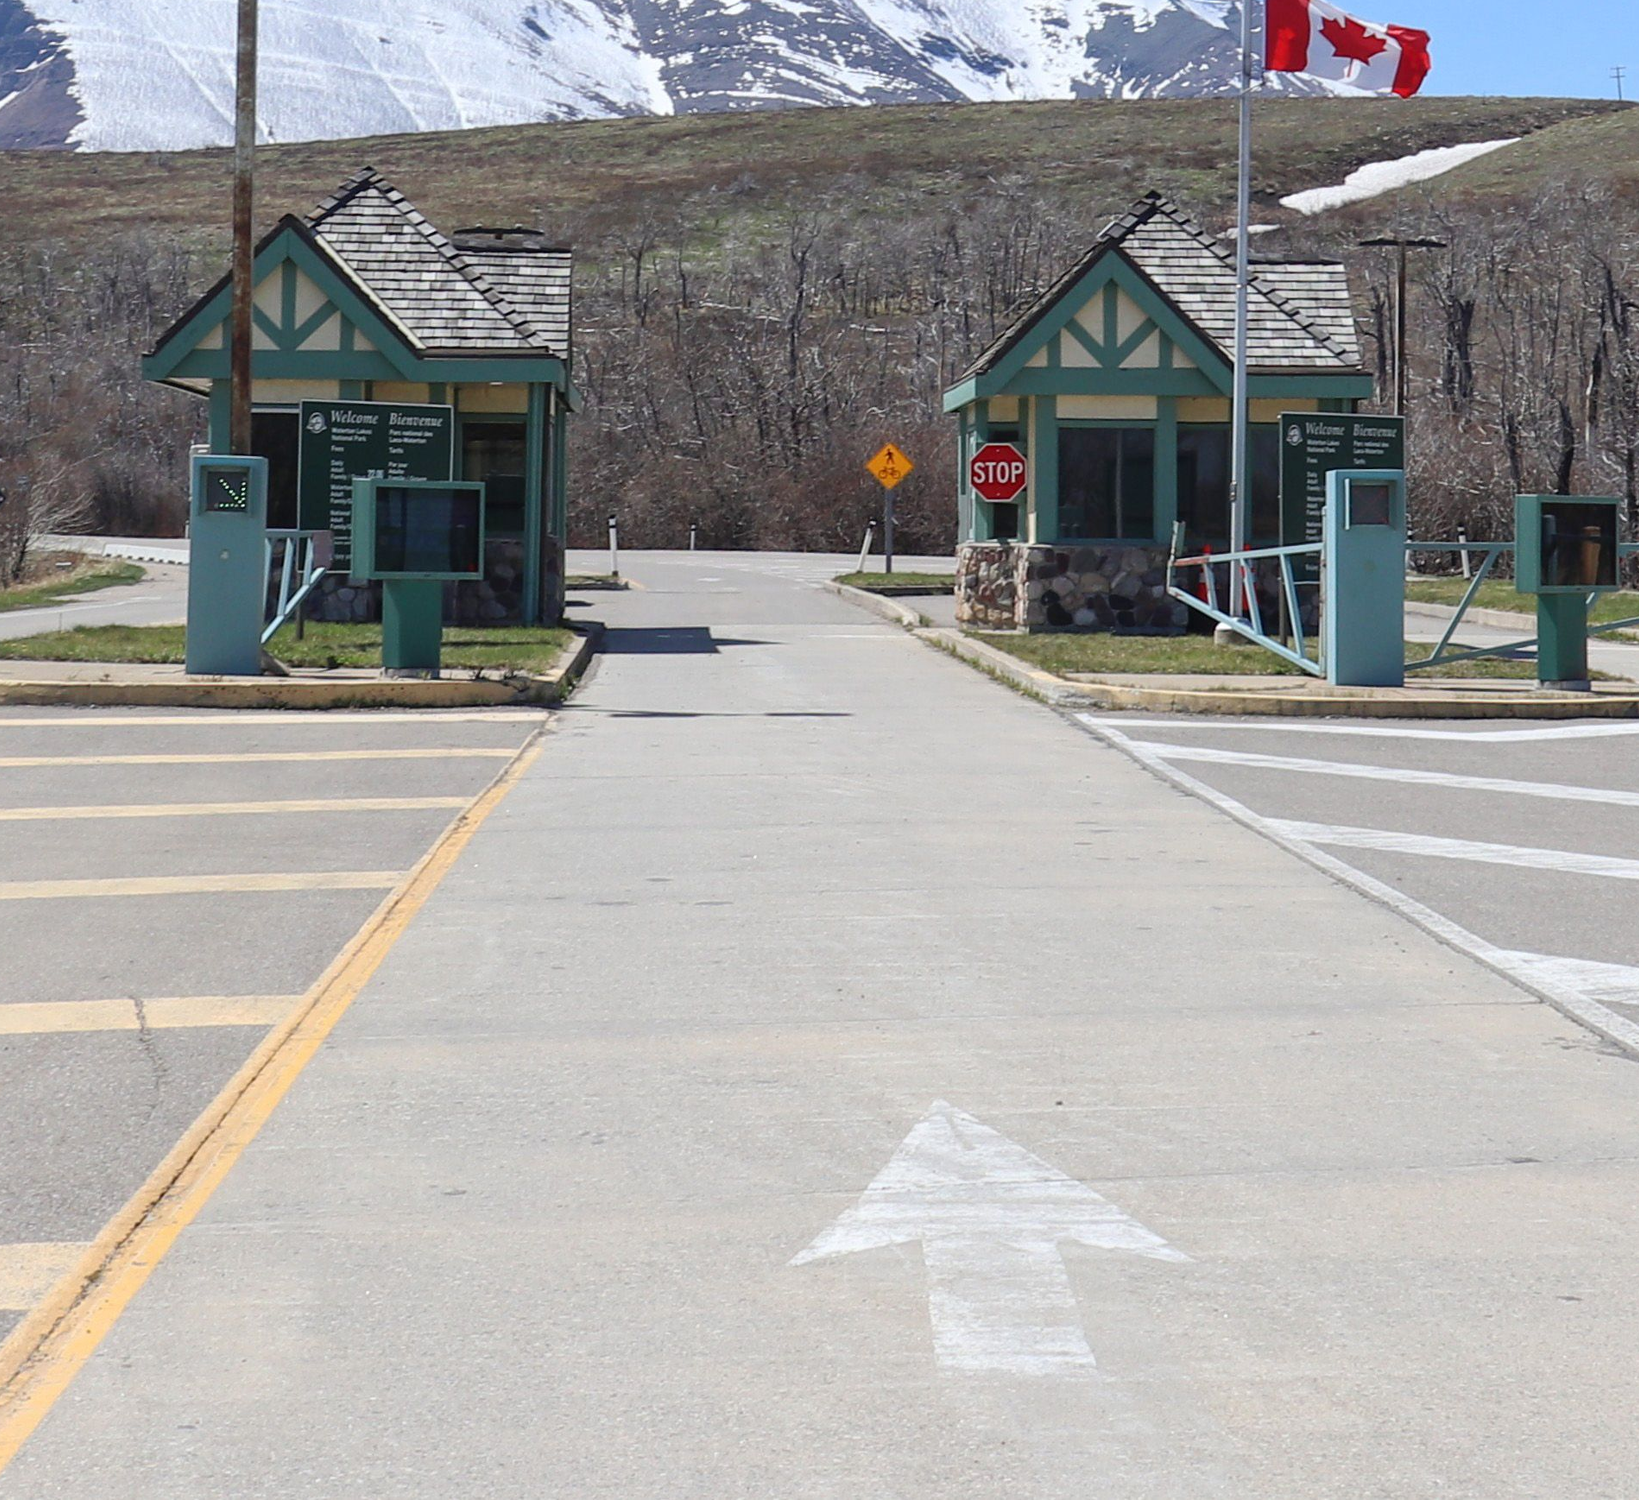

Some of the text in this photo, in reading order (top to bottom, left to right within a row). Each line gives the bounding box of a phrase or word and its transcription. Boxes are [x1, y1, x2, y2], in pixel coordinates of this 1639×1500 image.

[331, 410, 379, 424] Welcome
[389, 412, 443, 427] Bienvenue
[1305, 422, 1345, 436] Welcome
[1353, 423, 1398, 438] Bienvenue
[973, 462, 1023, 483] STOP
